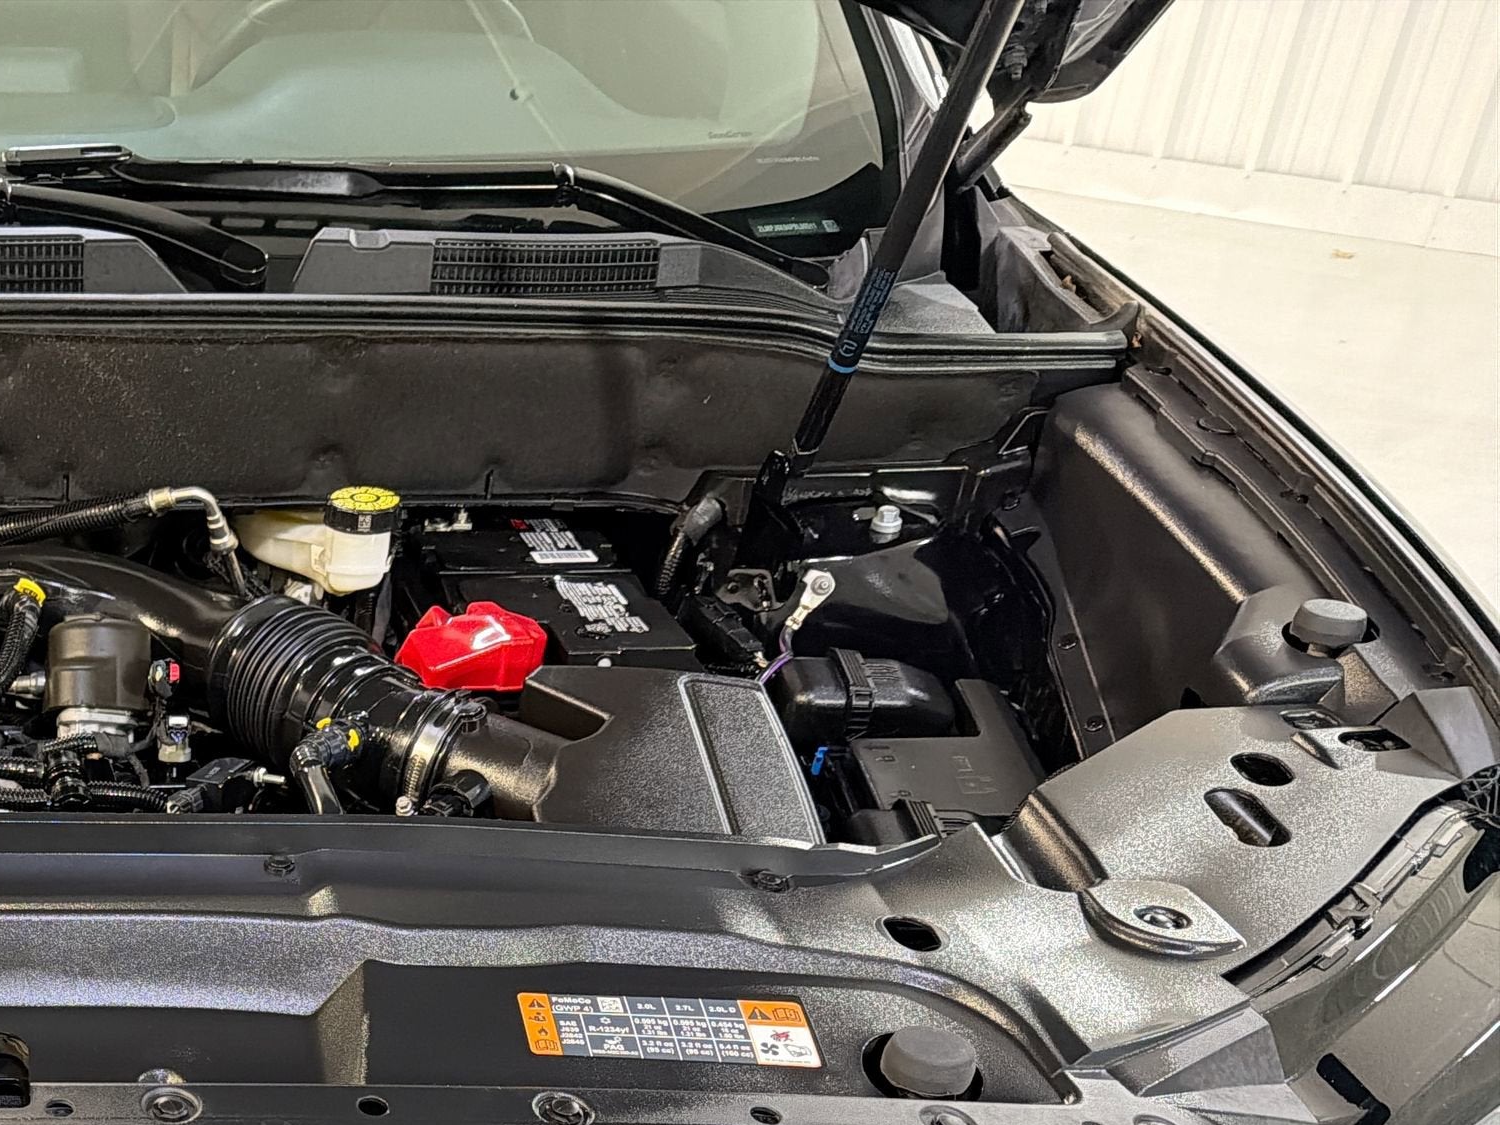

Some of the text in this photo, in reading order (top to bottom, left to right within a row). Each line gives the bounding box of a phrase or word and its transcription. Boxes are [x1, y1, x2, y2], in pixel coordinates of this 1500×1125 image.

[551, 996, 592, 1005] FoMoCo
[552, 1004, 594, 1013] (GWP 4)
[657, 1018, 668, 1026] kg
[696, 1020, 707, 1028] kg
[734, 1021, 745, 1030] kg
[588, 1025, 629, 1034] R-1234yf
[603, 1043, 625, 1051] PAG
